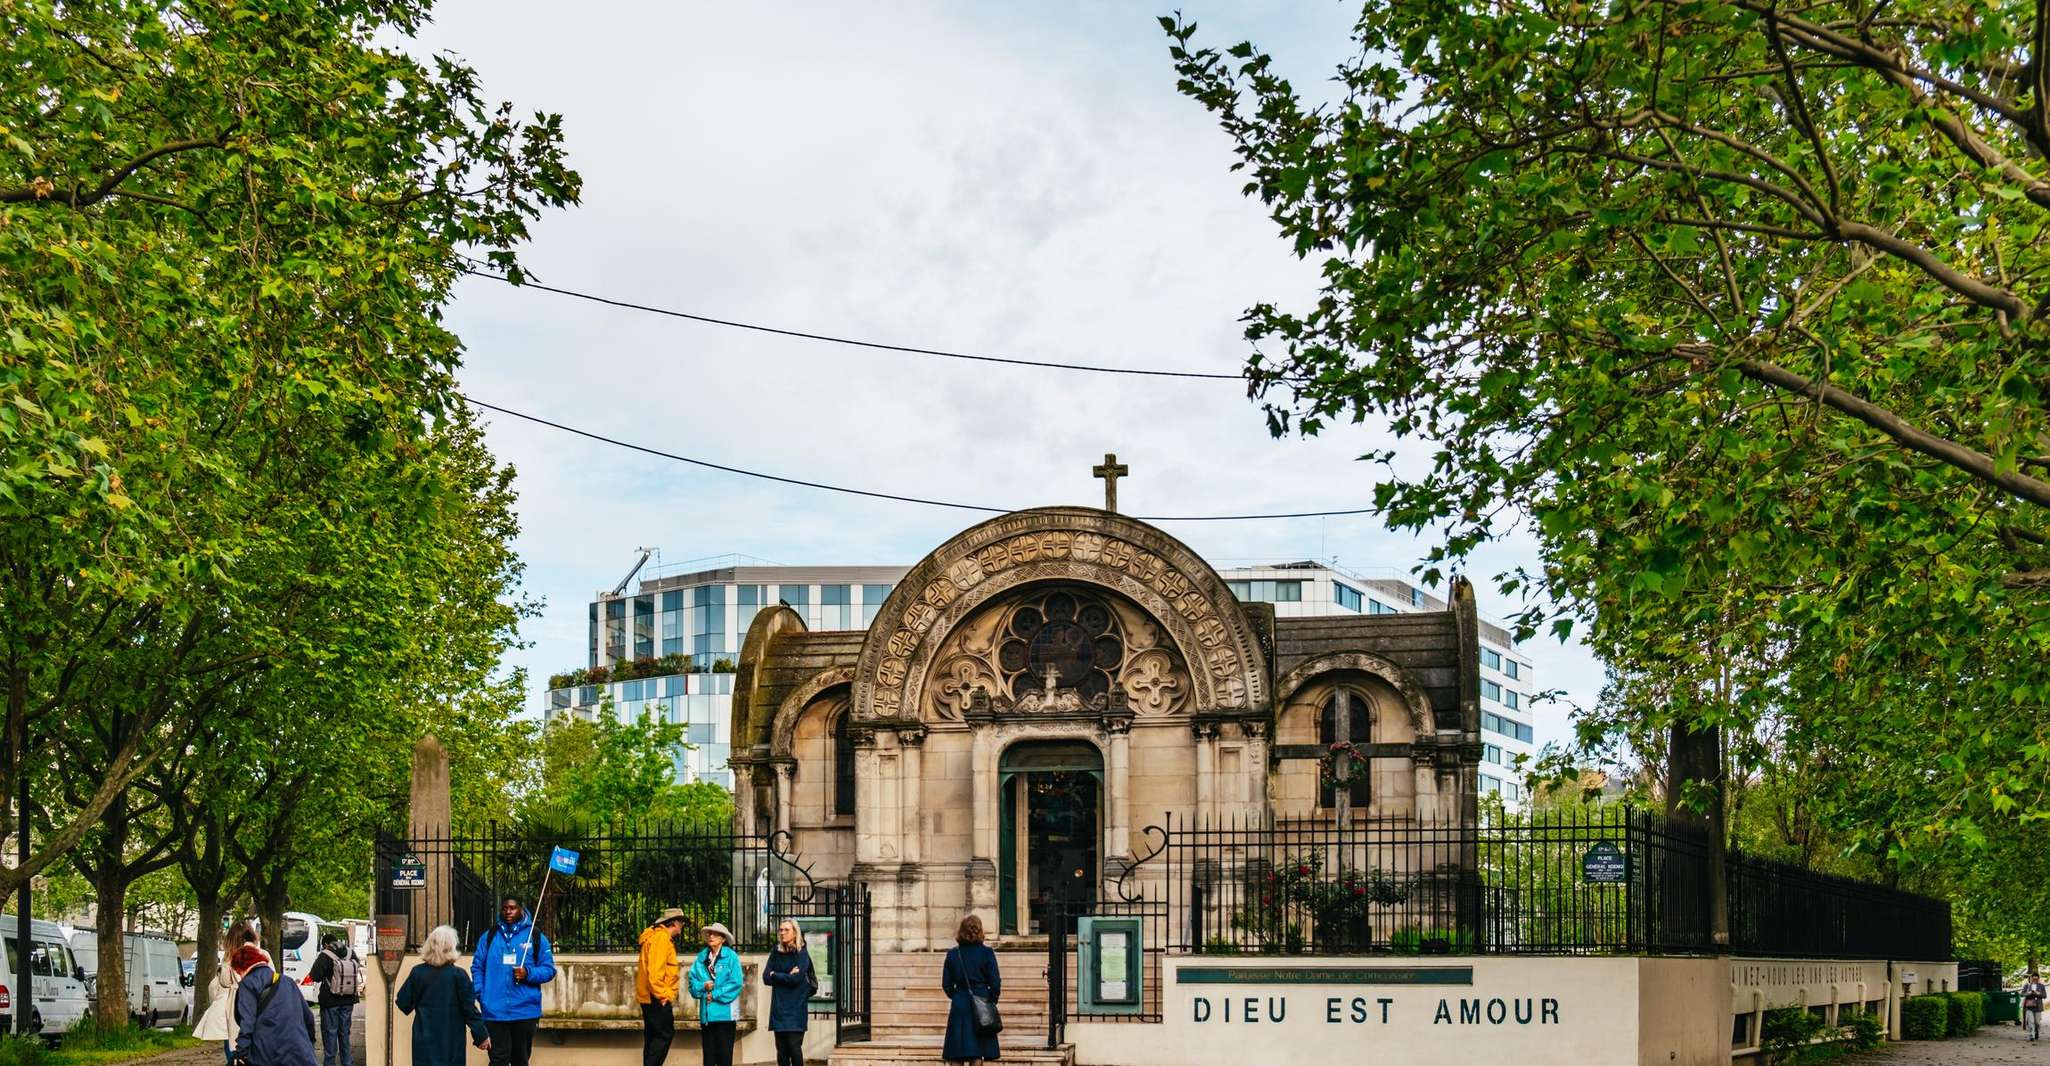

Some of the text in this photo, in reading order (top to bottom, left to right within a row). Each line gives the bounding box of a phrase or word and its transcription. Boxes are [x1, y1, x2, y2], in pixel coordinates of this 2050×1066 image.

[1274, 971, 1299, 980] Notre
[1791, 966, 1805, 985] LES
[1825, 966, 1837, 983] LES
[1193, 997, 1560, 1025] DIEU EST AMOUR
